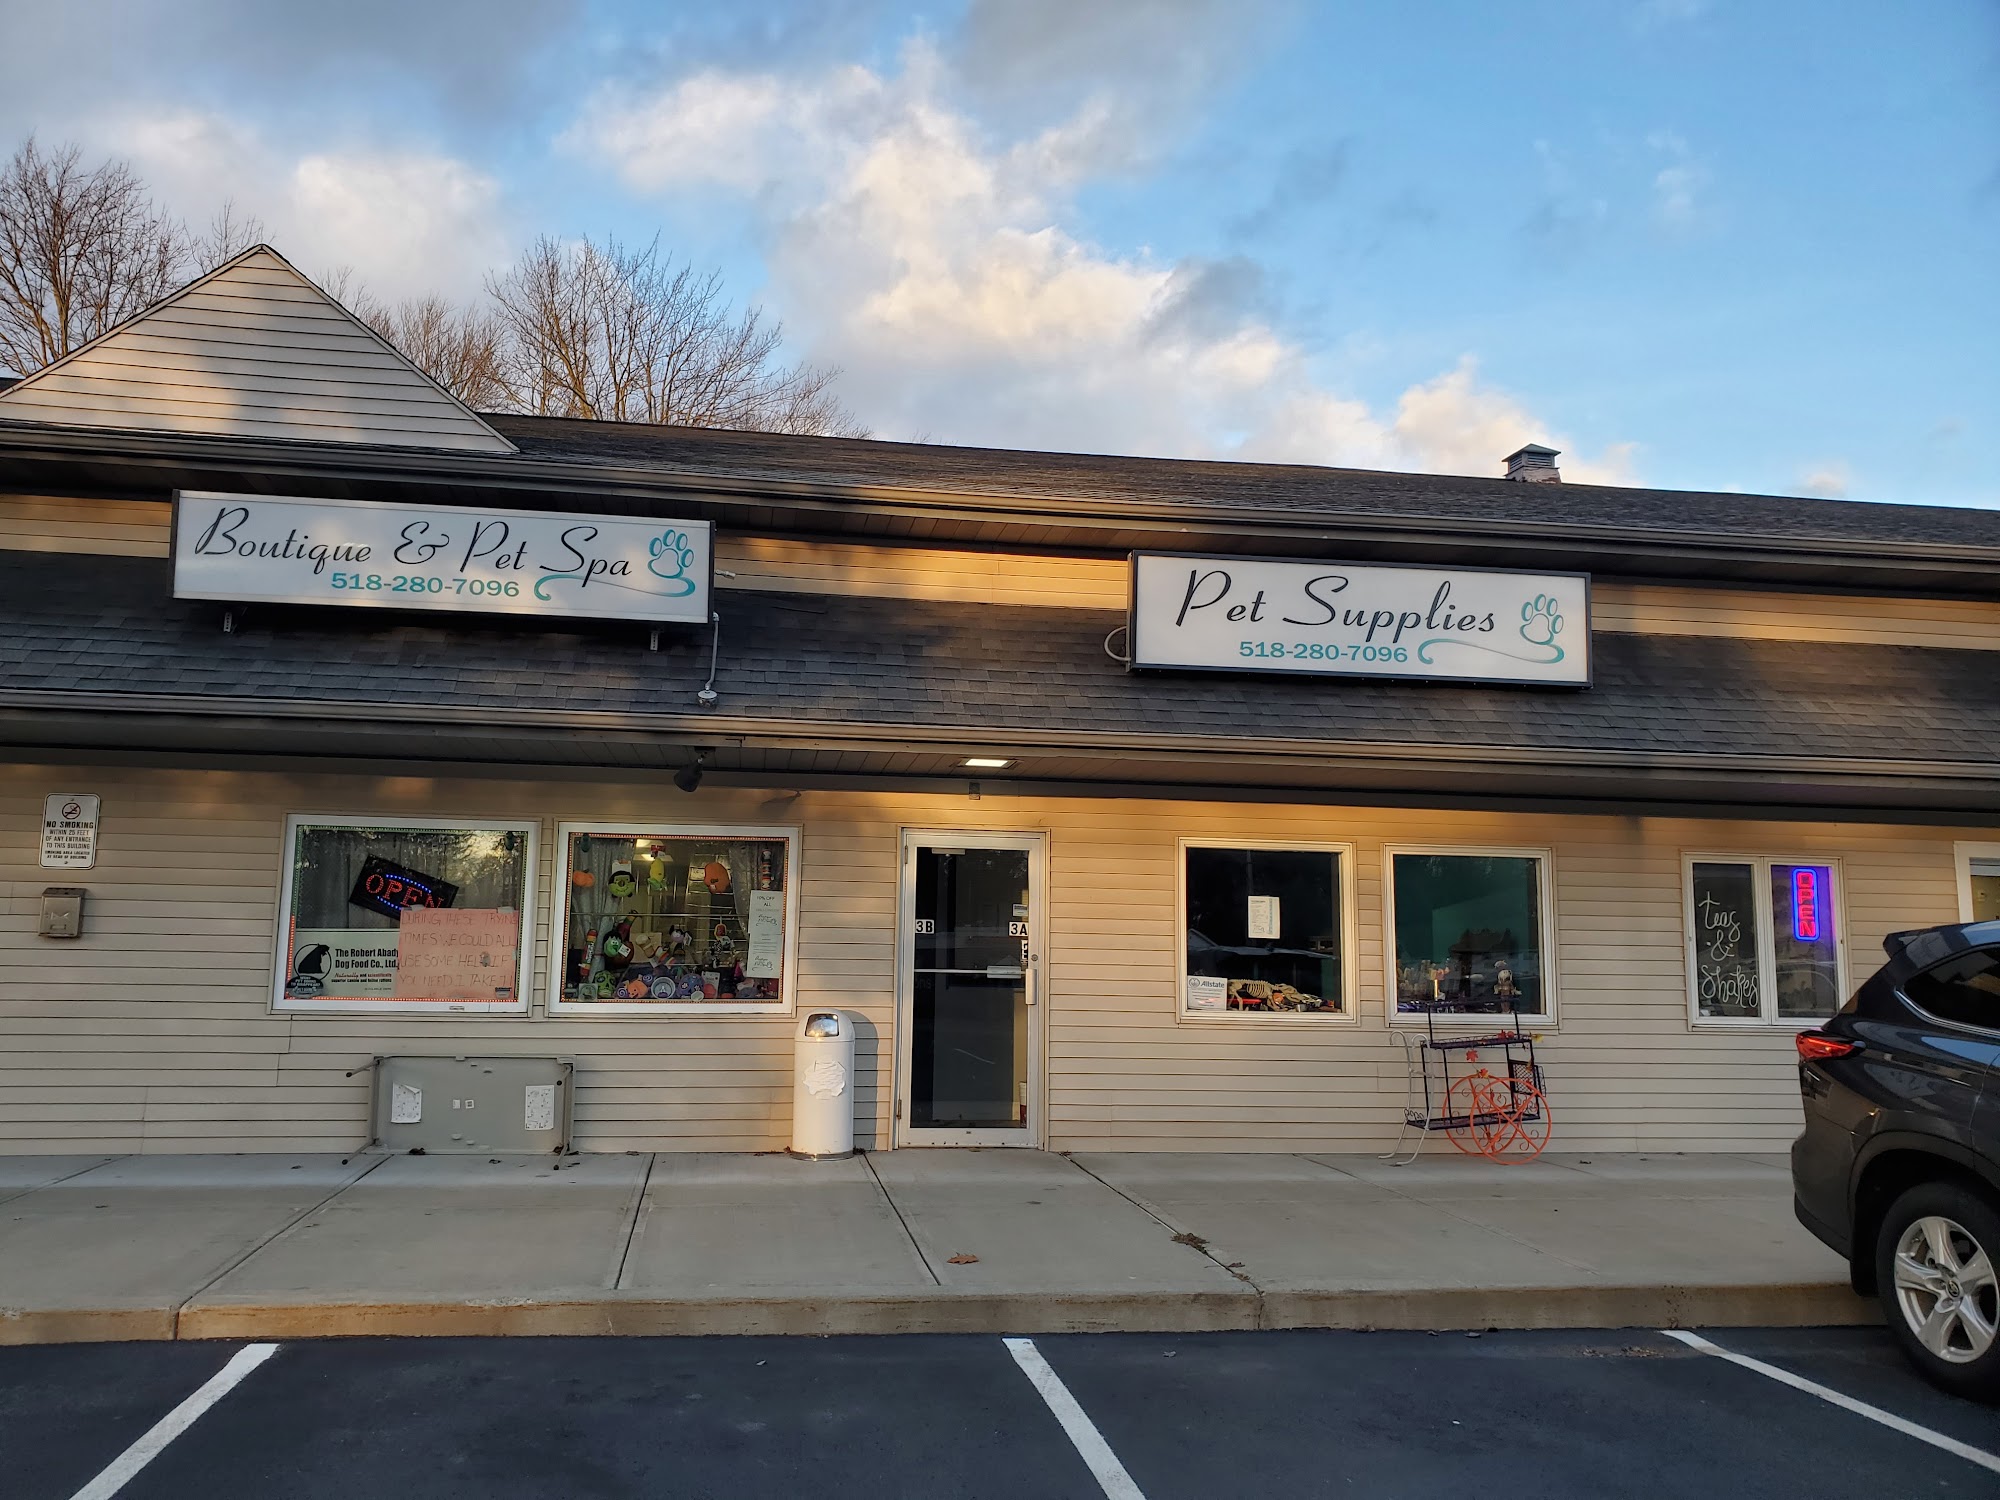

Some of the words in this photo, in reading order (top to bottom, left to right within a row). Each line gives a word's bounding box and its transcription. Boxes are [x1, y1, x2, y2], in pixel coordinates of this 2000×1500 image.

[194, 507, 372, 574] Boutique
[394, 521, 450, 565] &
[460, 521, 527, 573] Pet
[539, 526, 633, 587] Spa
[331, 572, 520, 598] 518-280-7096
[1175, 569, 1266, 627] Pet
[1282, 575, 1496, 644] Supplies
[1239, 641, 1408, 663] 518-280-7096
[46, 820, 57, 828] NO
[59, 821, 94, 829] SMOKING
[366, 873, 445, 908] OPEN
[1796, 872, 1816, 938] OPEN
[401, 912, 442, 925] DURING
[446, 912, 473, 926] THESE
[482, 912, 517, 926] TRYING
[915, 920, 934, 934] 3B
[1010, 923, 1028, 936] 3A
[402, 932, 438, 946] TIMES
[459, 933, 494, 947] COULD
[496, 934, 518, 947] ALL
[335, 948, 349, 957] The
[350, 948, 376, 957] Robert
[335, 959, 350, 969] Dog
[351, 959, 369, 968] Food
[400, 954, 422, 968] USE
[424, 953, 454, 968] SOME
[458, 953, 487, 968] HEL
[399, 974, 417, 986] YOU
[423, 974, 454, 987] NEED
[468, 973, 497, 987] TAKE
[1201, 980, 1225, 988] Allstate
